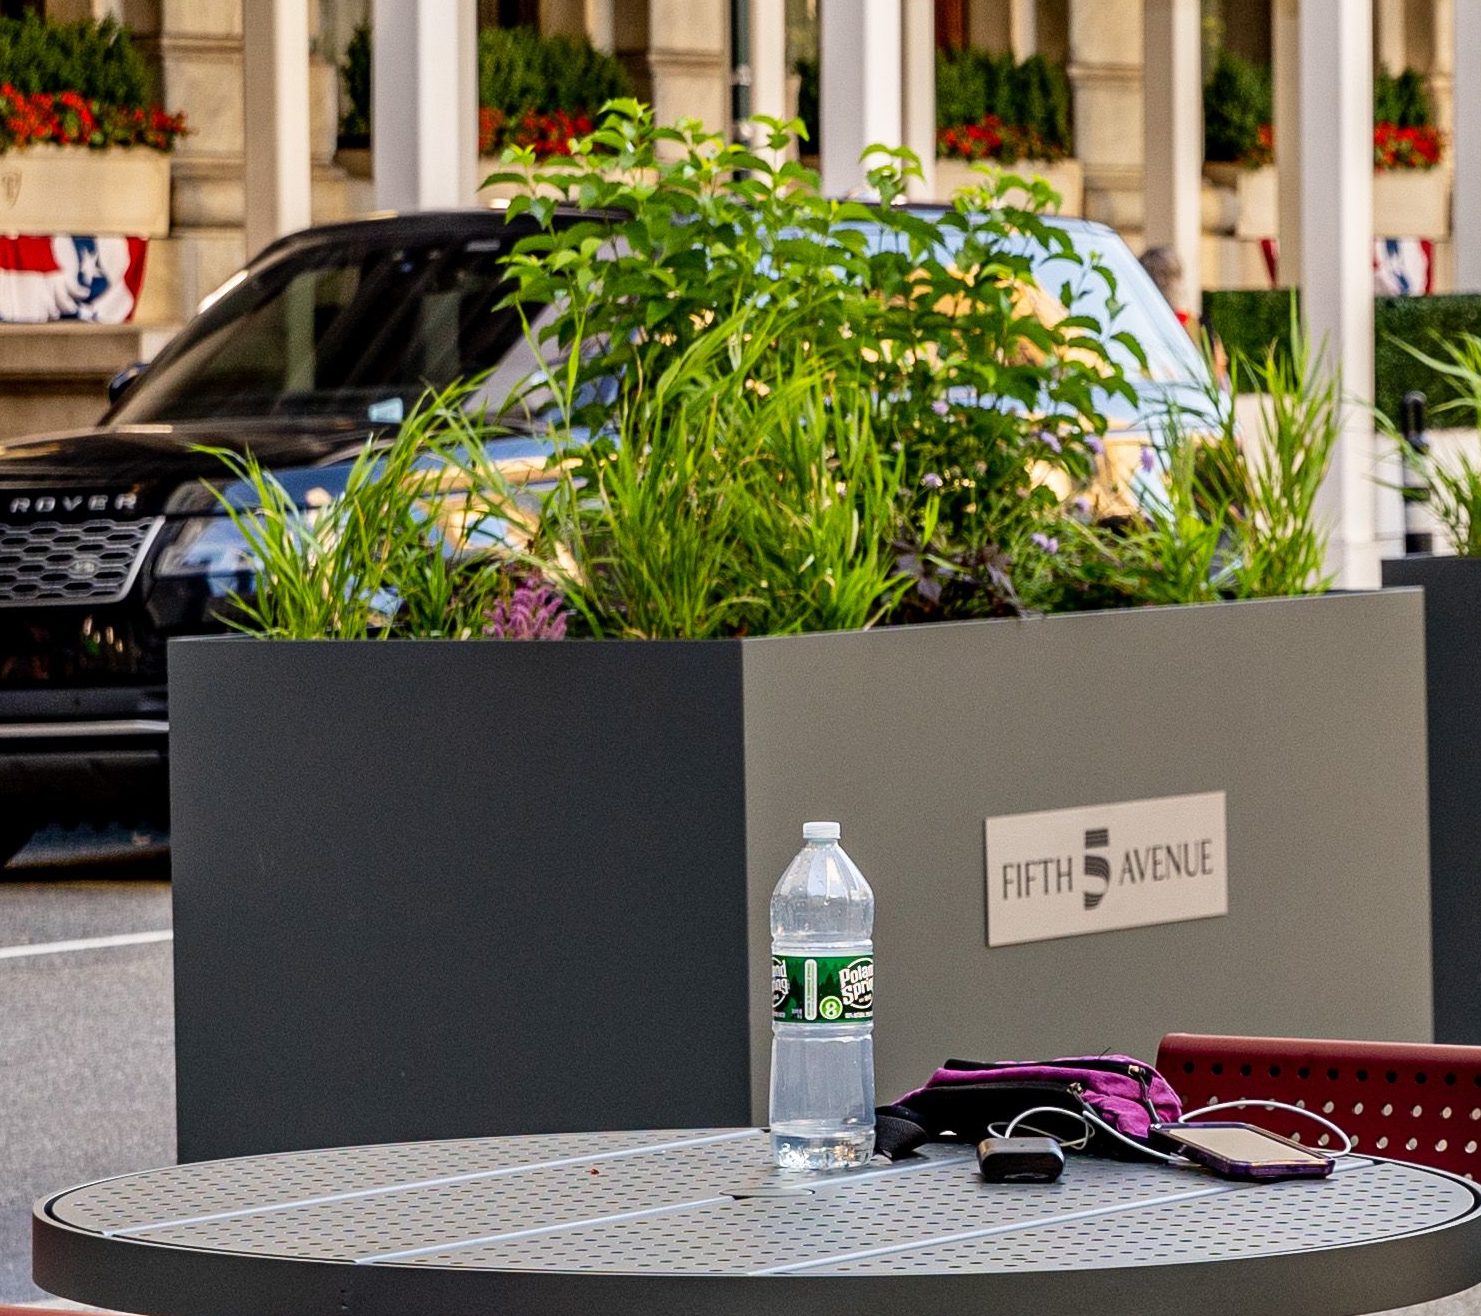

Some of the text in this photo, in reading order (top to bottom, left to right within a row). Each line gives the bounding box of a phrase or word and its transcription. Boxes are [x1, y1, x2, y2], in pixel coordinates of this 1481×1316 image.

[10, 492, 138, 514] ROVER
[1002, 827, 1216, 912] FIFTH 5 AVENUE
